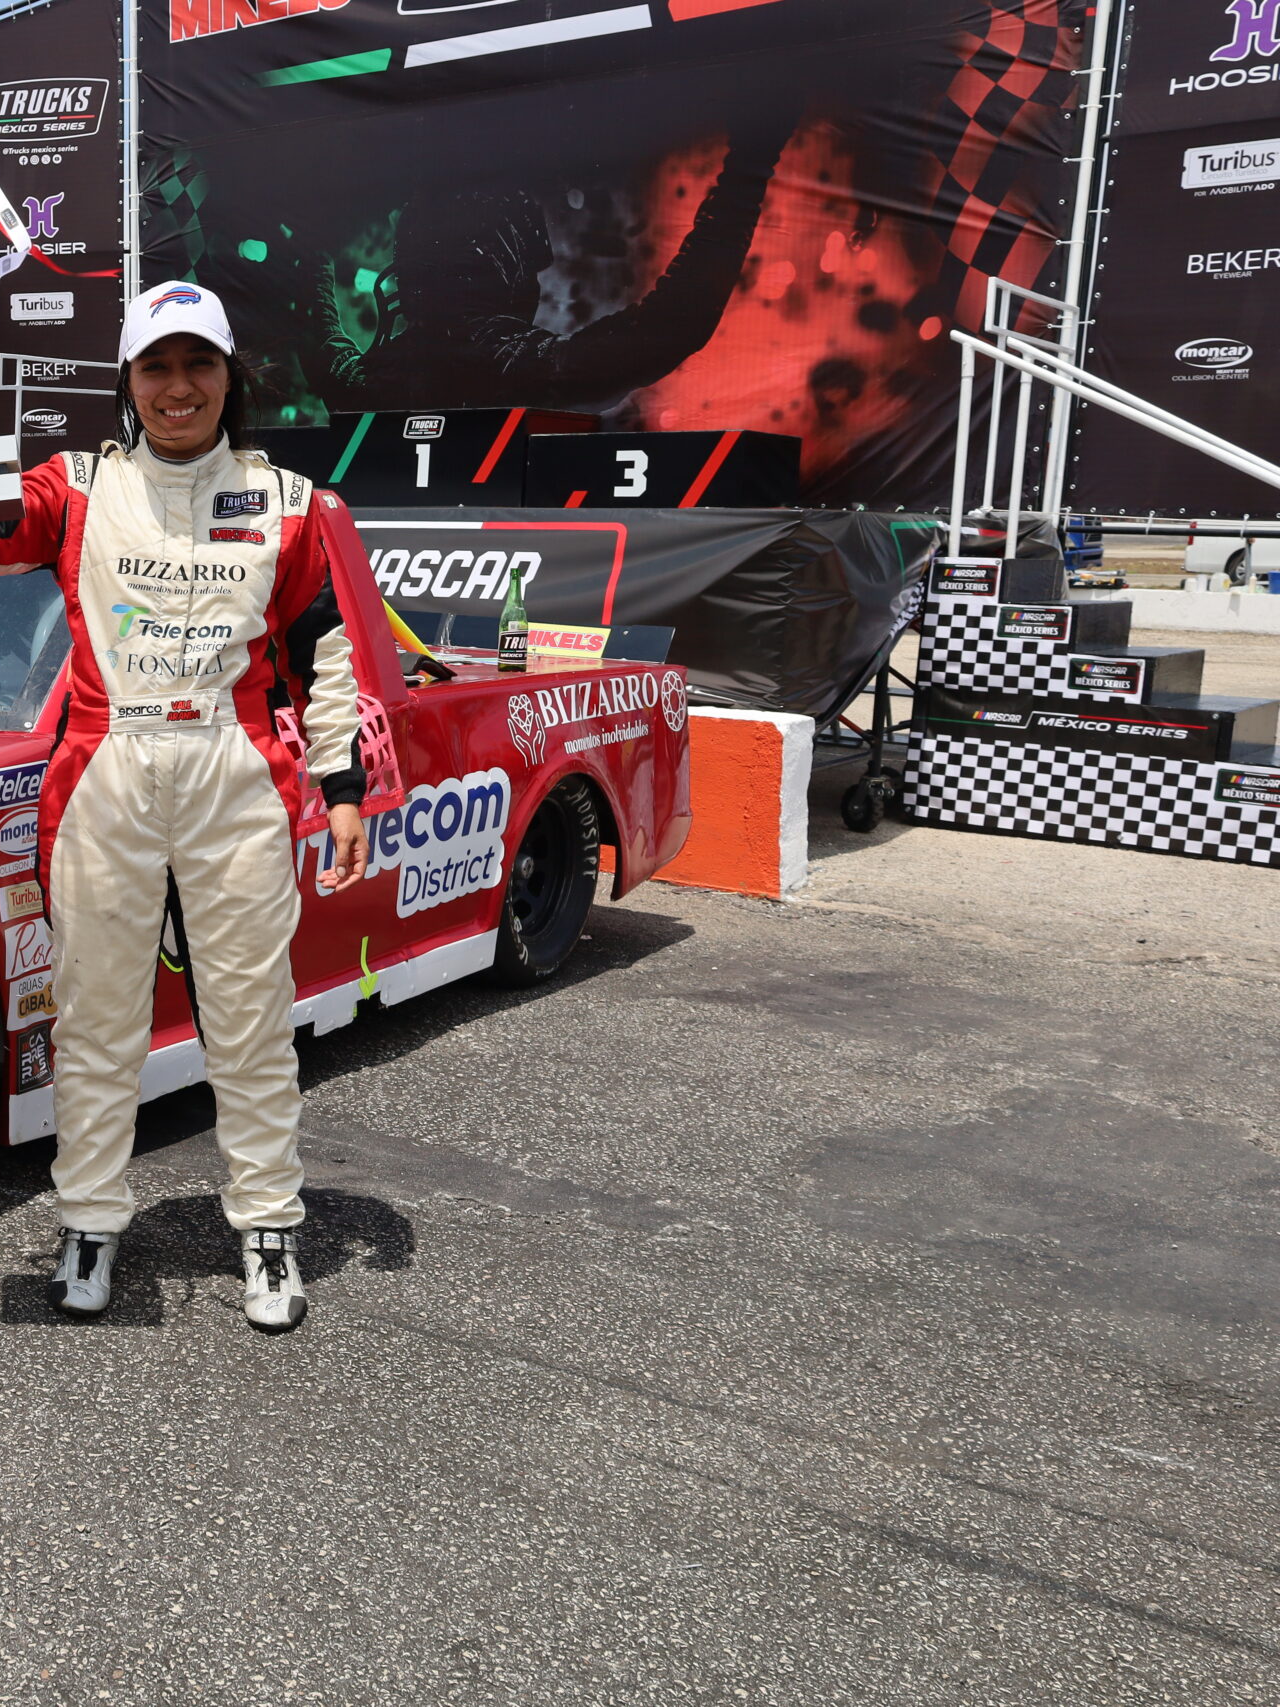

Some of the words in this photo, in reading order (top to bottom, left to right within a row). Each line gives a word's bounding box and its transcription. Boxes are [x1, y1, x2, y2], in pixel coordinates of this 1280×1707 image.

[1169, 63, 1280, 95] HOOSI
[0, 86, 92, 116] TRUCKS
[42, 121, 86, 132] SERIES
[1198, 150, 1275, 173] Turibus
[1209, 185, 1253, 196] MOBILITY
[1254, 183, 1275, 192] ADO
[1186, 248, 1280, 274] BEKER
[1214, 271, 1252, 279] EYEWEAR
[19, 297, 65, 311] Turibus
[1182, 346, 1246, 359] moncar
[22, 363, 77, 377] BEKER
[26, 414, 62, 423] moncar
[411, 420, 439, 429] TRUCKS
[74, 453, 87, 484] parco
[416, 444, 431, 487] 1
[613, 450, 648, 497] 3
[289, 474, 302, 507] spar
[223, 493, 260, 508] TRUCKS
[116, 557, 246, 582] BIZZARRO
[369, 549, 542, 601] ASCAR
[954, 569, 987, 578] NASCAR
[127, 582, 171, 594] momentos
[938, 581, 963, 590] MÉXICO
[964, 583, 989, 591] SERIES
[1022, 612, 1056, 621] NASCAR
[139, 618, 233, 640] Telecom
[1005, 624, 1032, 634] MÉXICO
[1034, 627, 1059, 635] SERIES
[182, 641, 228, 655] District
[504, 635, 528, 649] TRU
[1092, 665, 1128, 675] NASCAR
[1075, 676, 1103, 687] MÉXICO
[1104, 679, 1131, 689] SERIES
[171, 700, 192, 710] VALE
[534, 672, 658, 728] BIZZARRO
[118, 705, 162, 718] sparco
[166, 710, 200, 722] ARANDA
[984, 711, 1022, 723] NASCAR
[1037, 715, 1111, 732] MÉXICO
[1115, 724, 1189, 740] SERIES
[1222, 788, 1254, 799] MÉXICO
[0, 821, 38, 843] monc
[323, 782, 504, 871] lecom
[402, 846, 495, 906] District
[10, 889, 42, 906] Turibu
